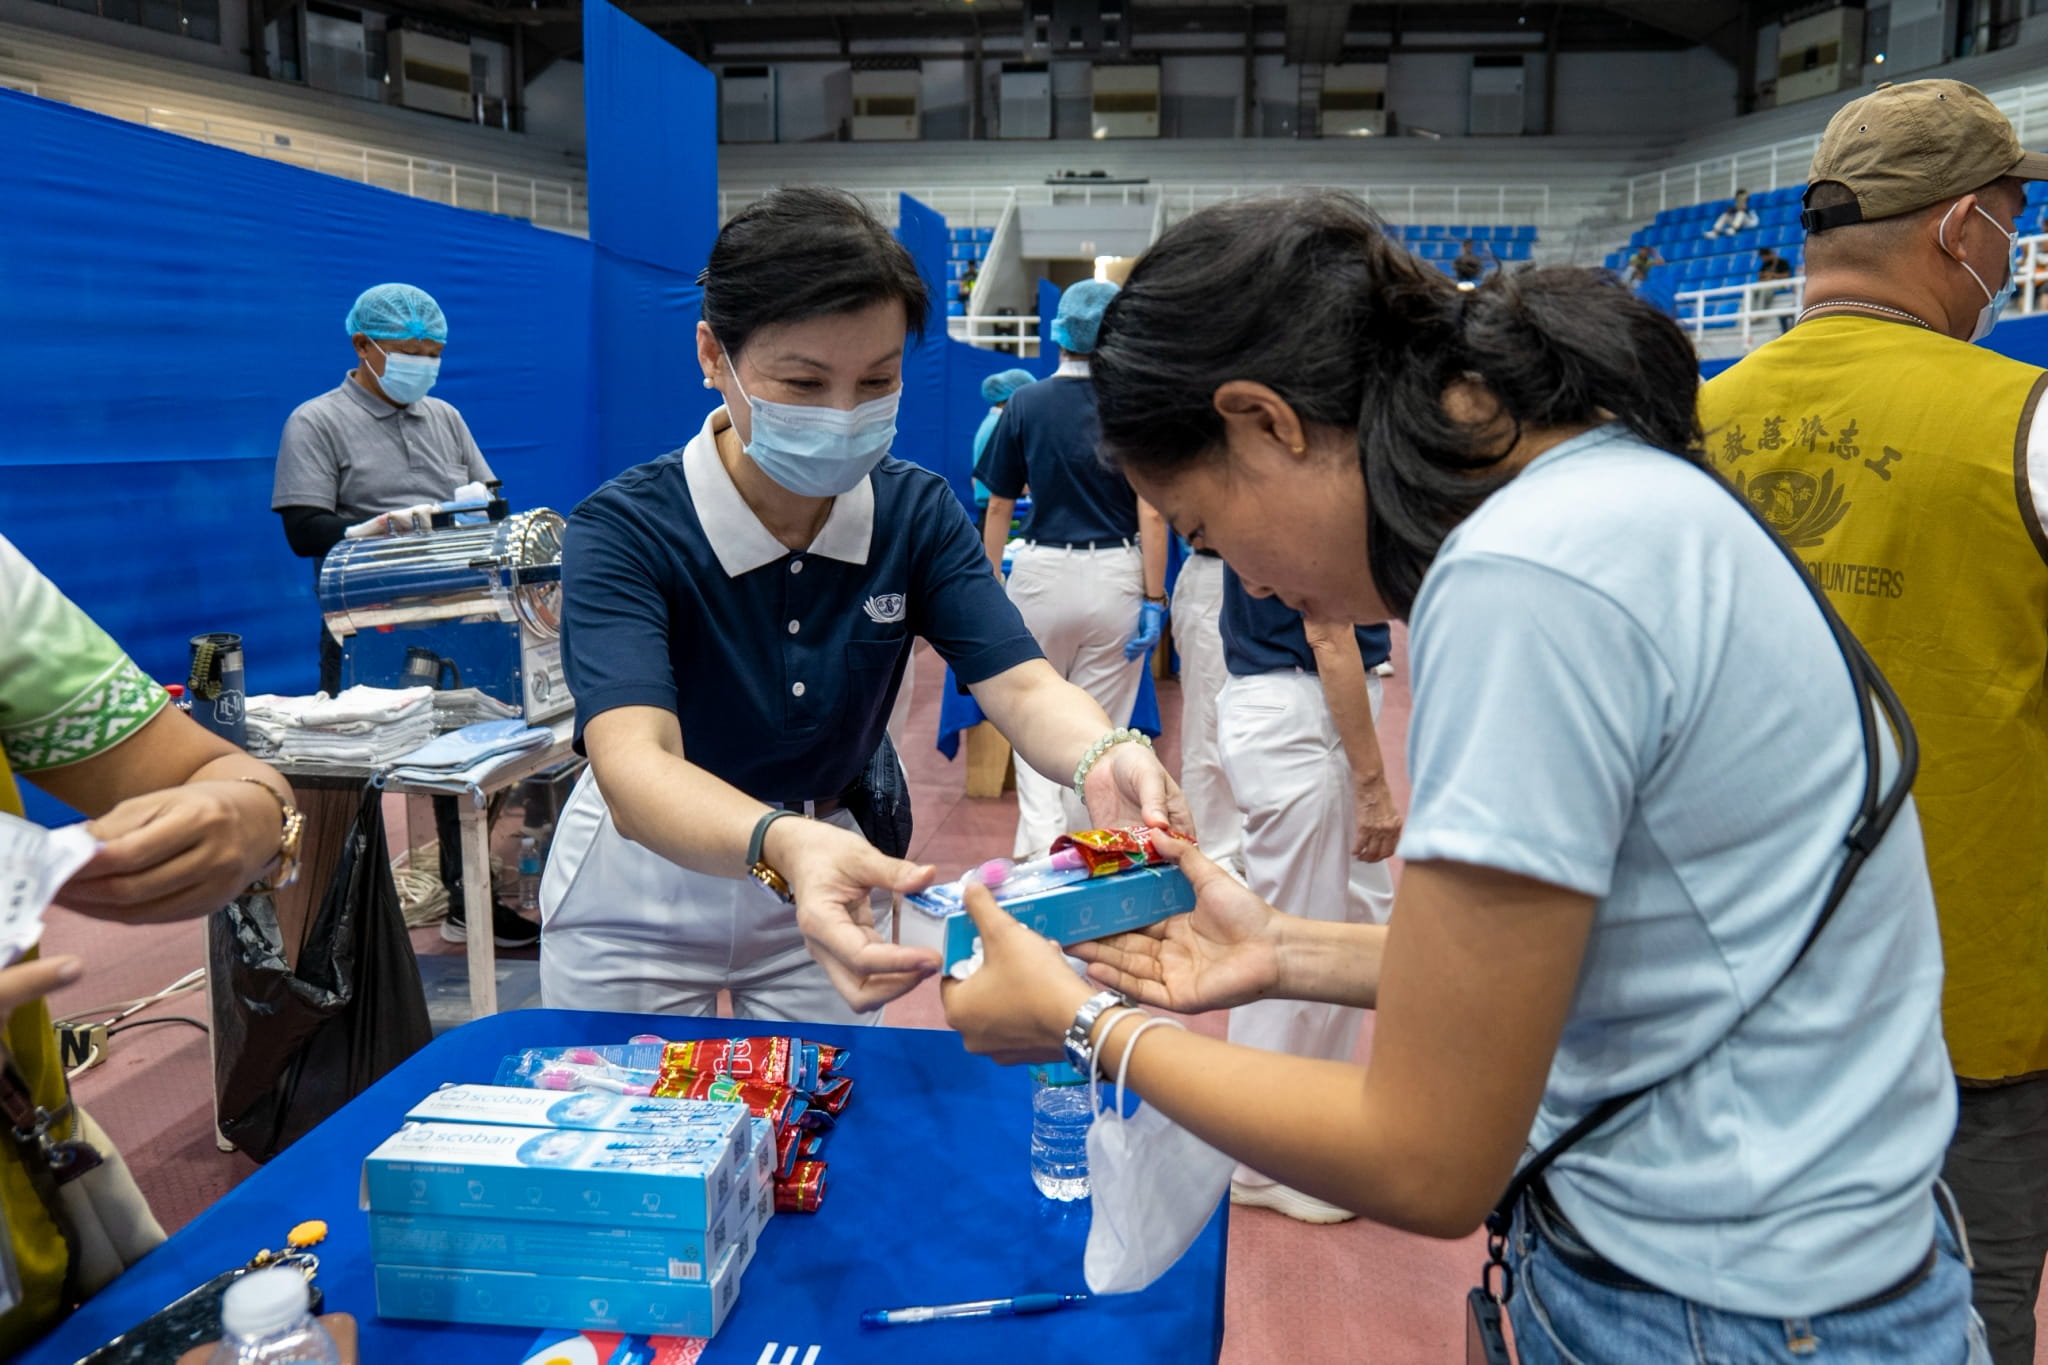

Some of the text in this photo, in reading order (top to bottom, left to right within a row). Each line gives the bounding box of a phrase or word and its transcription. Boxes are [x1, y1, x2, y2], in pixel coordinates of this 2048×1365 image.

[1804, 561, 1905, 599] OLUNTEERS
[61, 1028, 91, 1067] N
[470, 1091, 546, 1106] scoban
[434, 1130, 516, 1145] scoban
